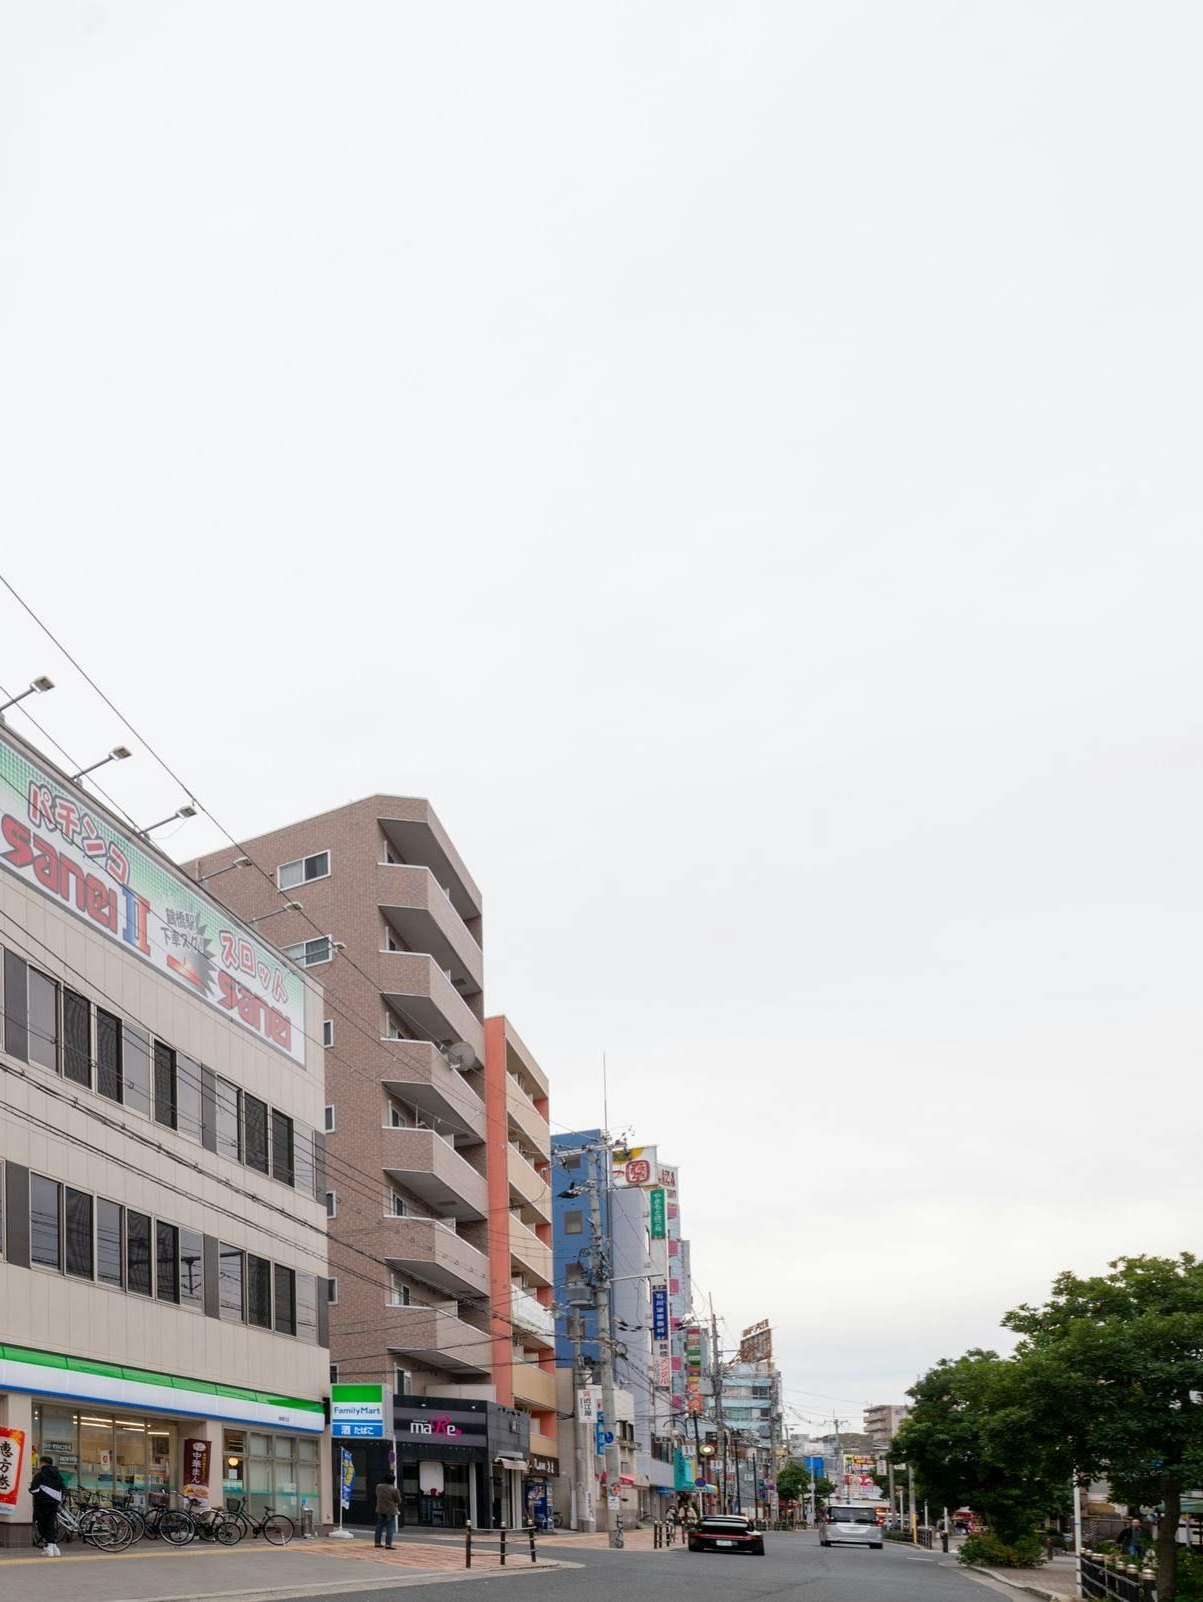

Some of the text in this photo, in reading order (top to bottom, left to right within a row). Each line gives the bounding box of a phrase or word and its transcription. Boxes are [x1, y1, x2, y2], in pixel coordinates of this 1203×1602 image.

[28, 780, 130, 886] パチンコ
[219, 930, 288, 1004] スロット
[333, 1406, 380, 1416] FamilyMart
[341, 1425, 375, 1435] 酒 たばこ
[191, 1452, 202, 1484] 中華まん
